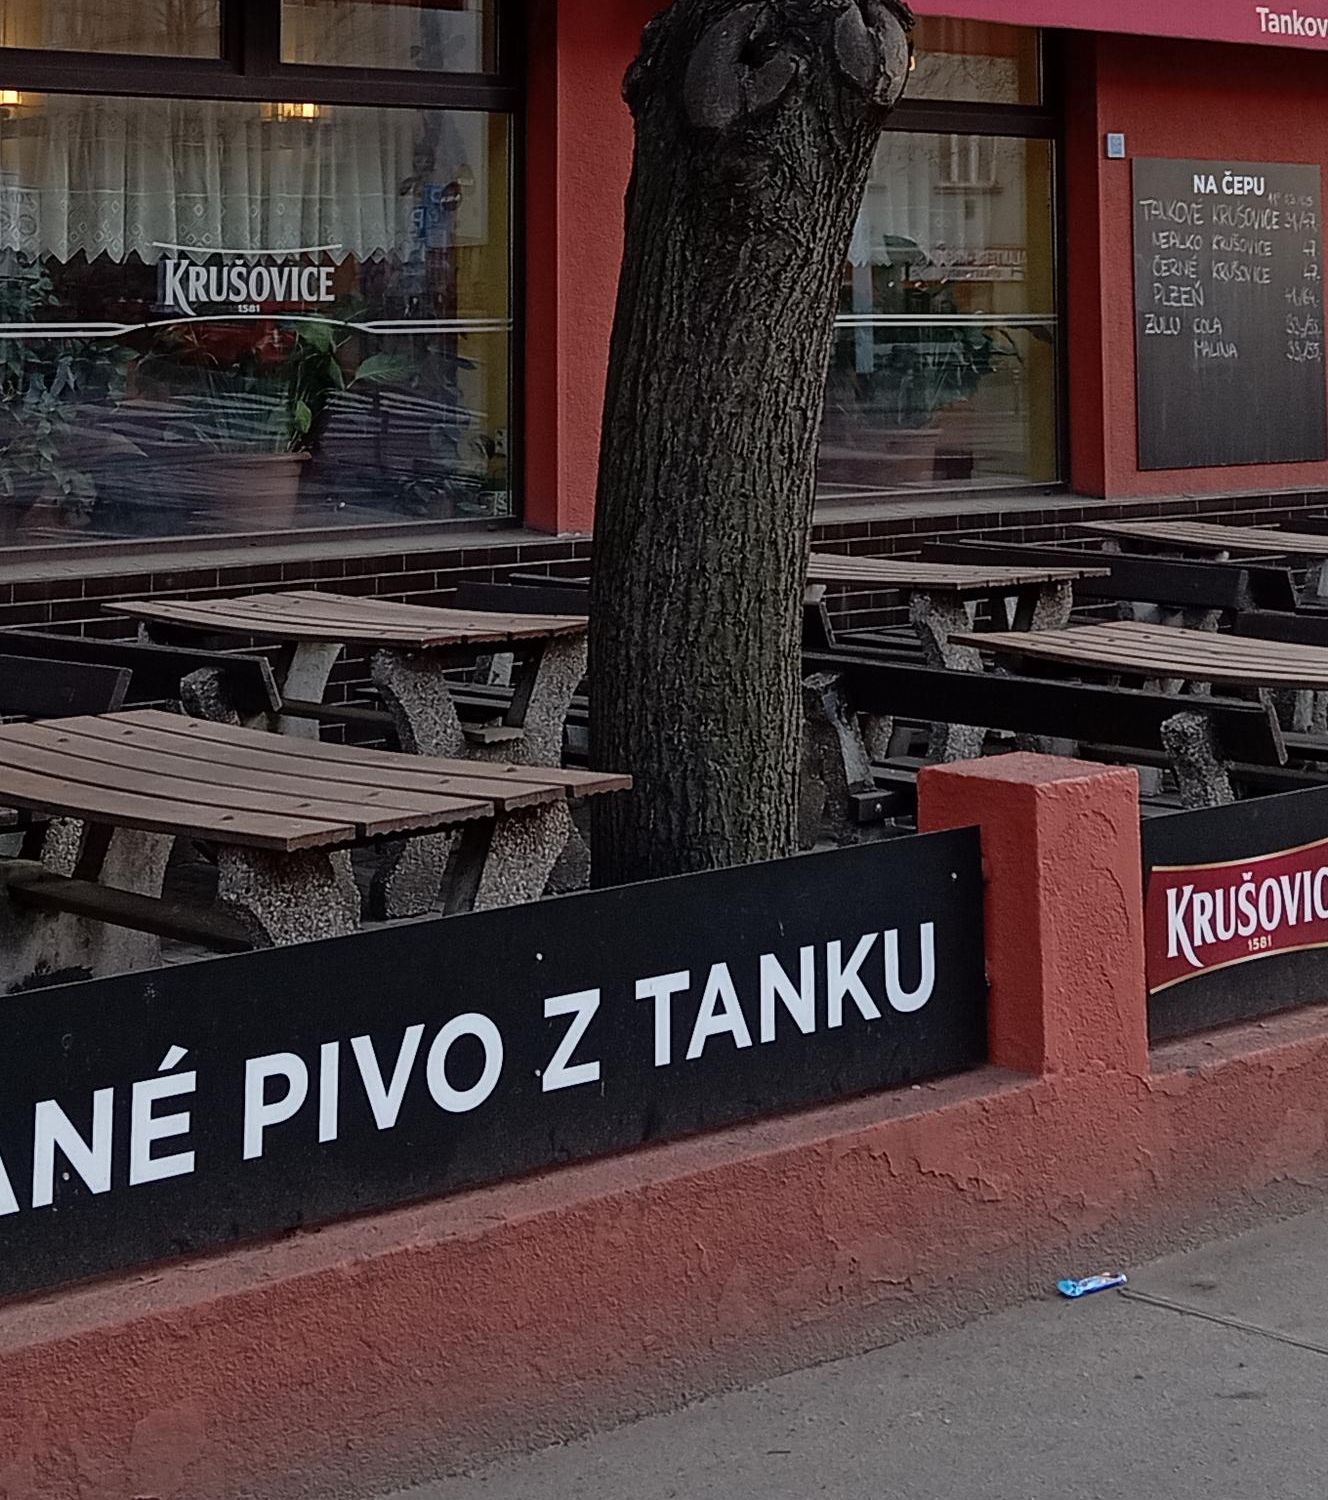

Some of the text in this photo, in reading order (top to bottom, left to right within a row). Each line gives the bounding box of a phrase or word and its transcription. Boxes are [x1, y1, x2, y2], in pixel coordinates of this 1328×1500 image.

[1193, 170, 1265, 196] NA ČEPU
[165, 258, 335, 315] KRUŠOVICE
[237, 303, 261, 313] 1581
[1193, 316, 1223, 335] COLA
[1248, 936, 1272, 954] 1581
[243, 1012, 504, 1161] PIVO
[542, 988, 601, 1093] Z
[635, 921, 936, 1068] TANKU
